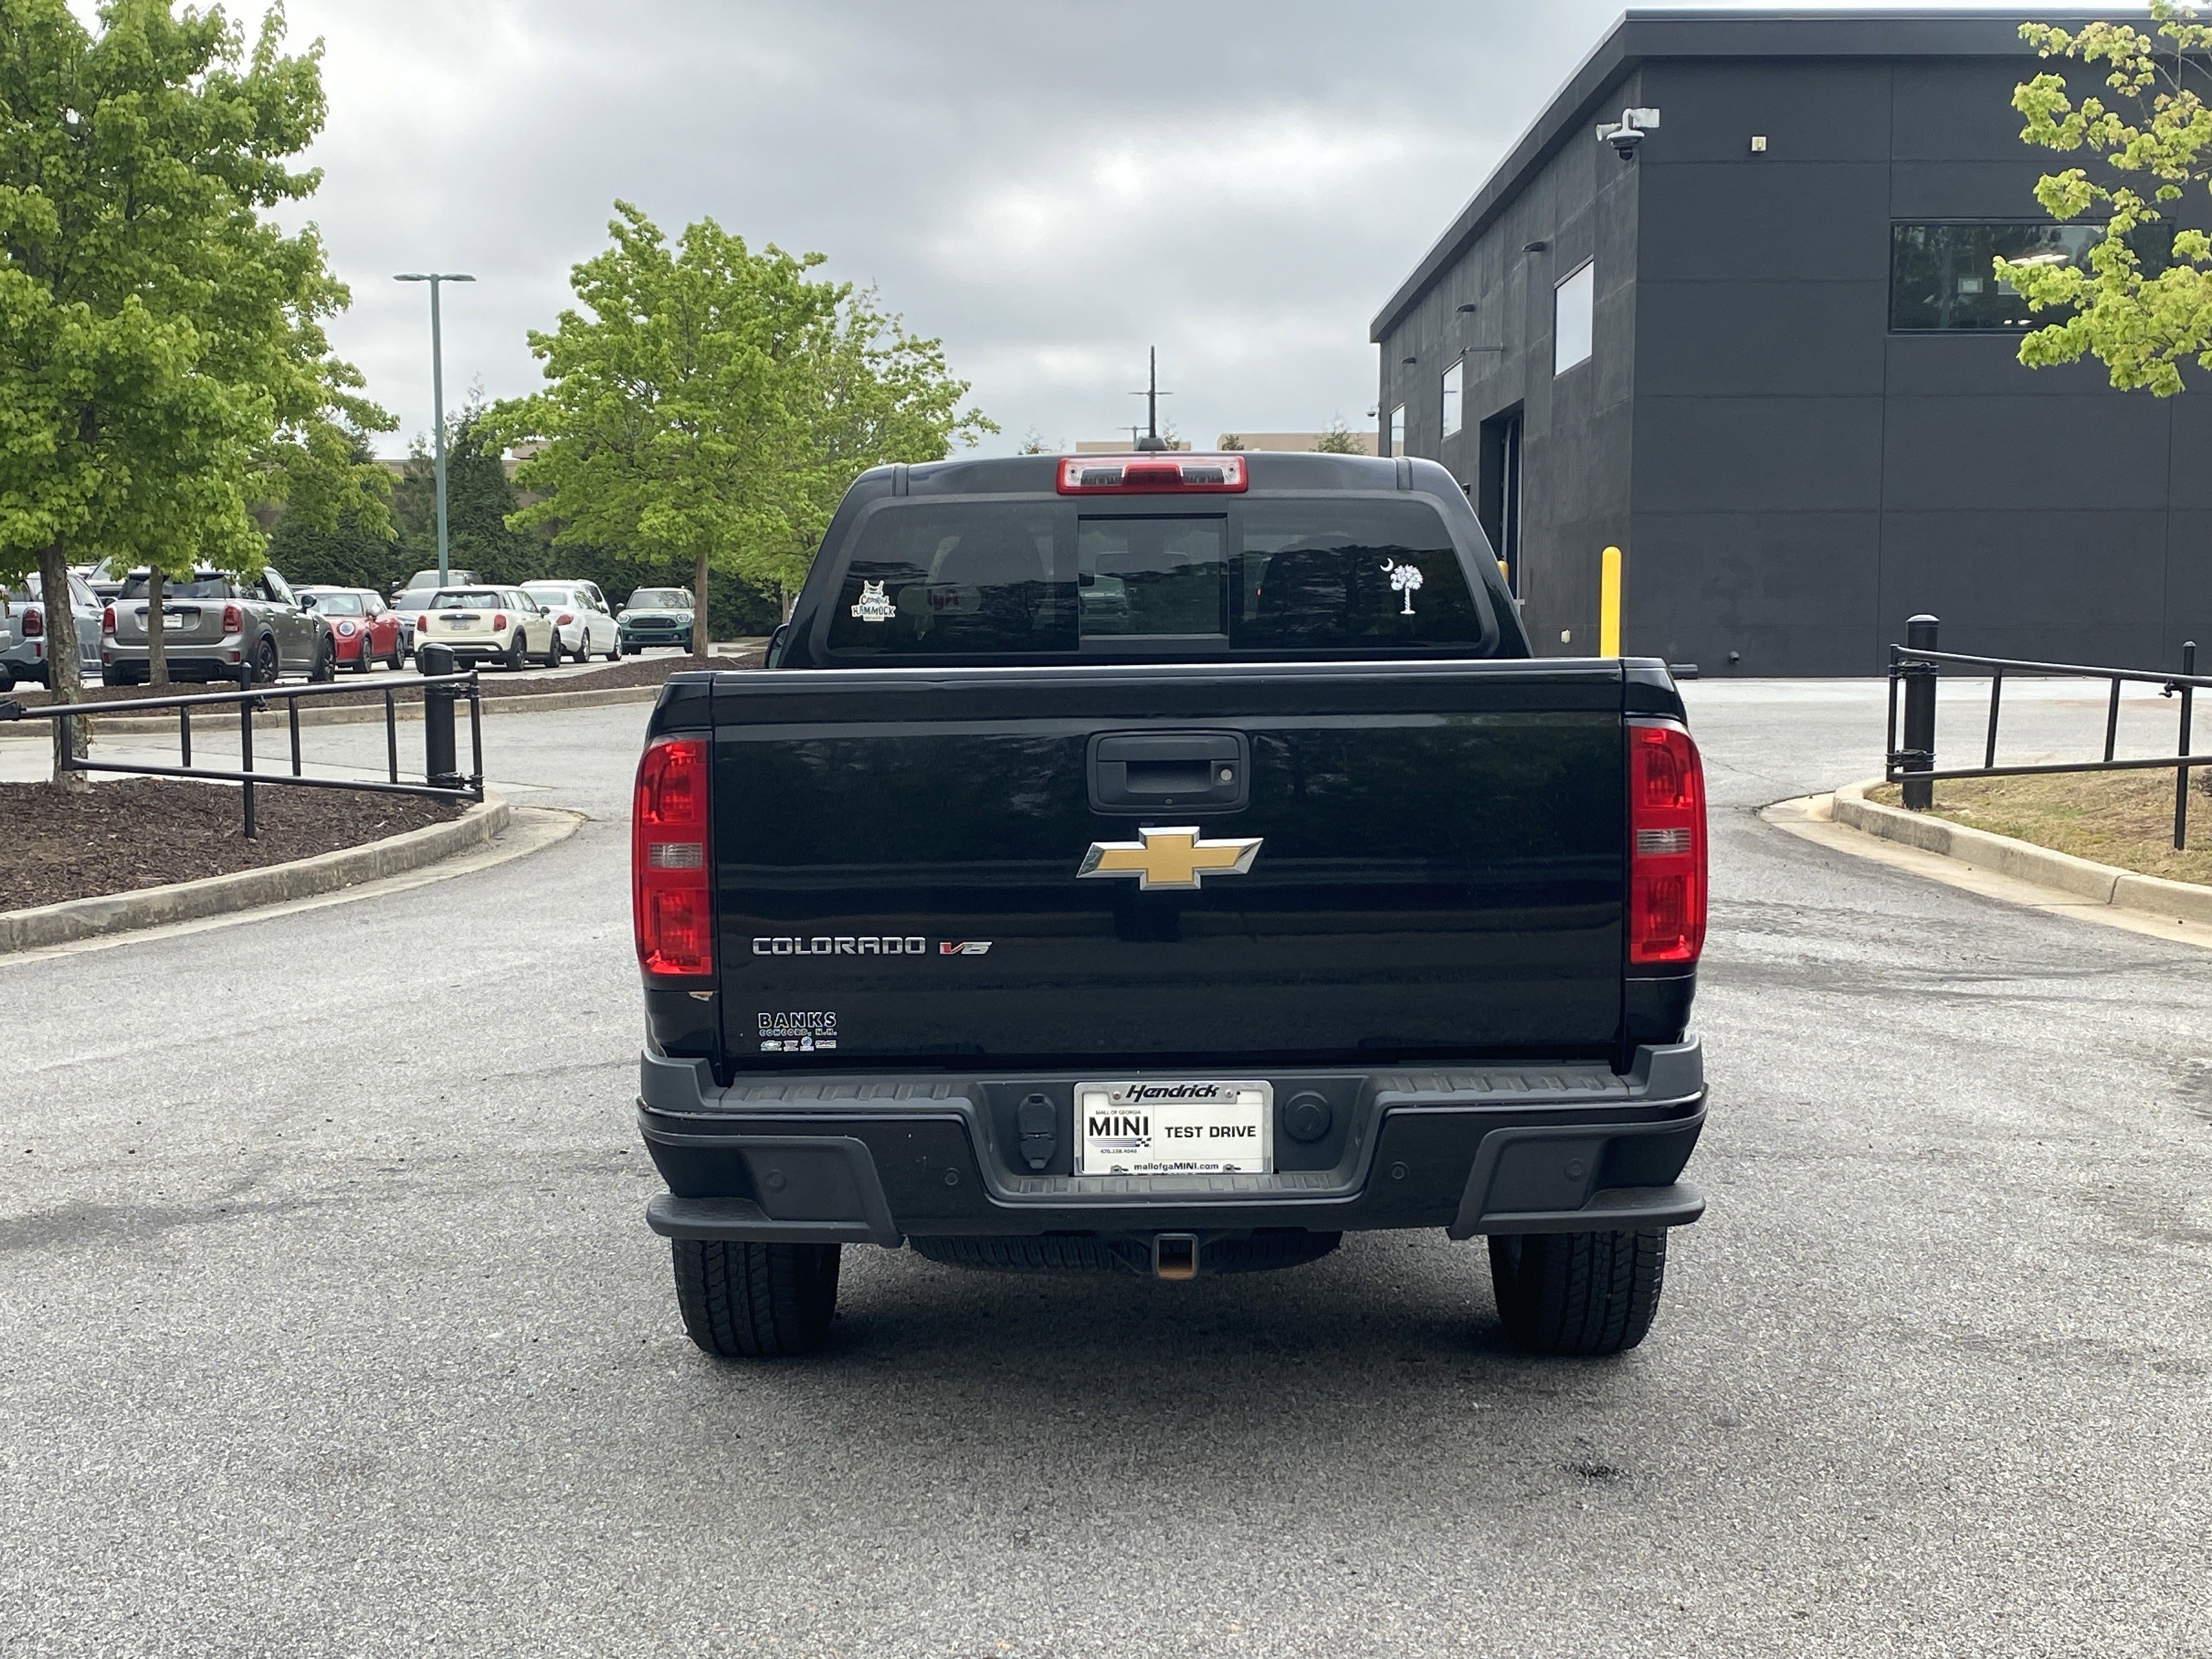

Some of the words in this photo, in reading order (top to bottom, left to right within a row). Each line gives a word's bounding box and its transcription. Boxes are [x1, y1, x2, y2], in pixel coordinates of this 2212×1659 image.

[853, 605, 894, 616] HAMMOCK
[752, 936, 926, 955] COLORADO
[939, 941, 992, 955] V6
[758, 1012, 837, 1029] BANKS
[1125, 1084, 1220, 1103] Hendrick
[1089, 1116, 1149, 1136] MINI
[1165, 1126, 1203, 1138] TEST
[1210, 1126, 1256, 1138] DRIVE
[1134, 1163, 1219, 1171] mallofgaMINI.com
